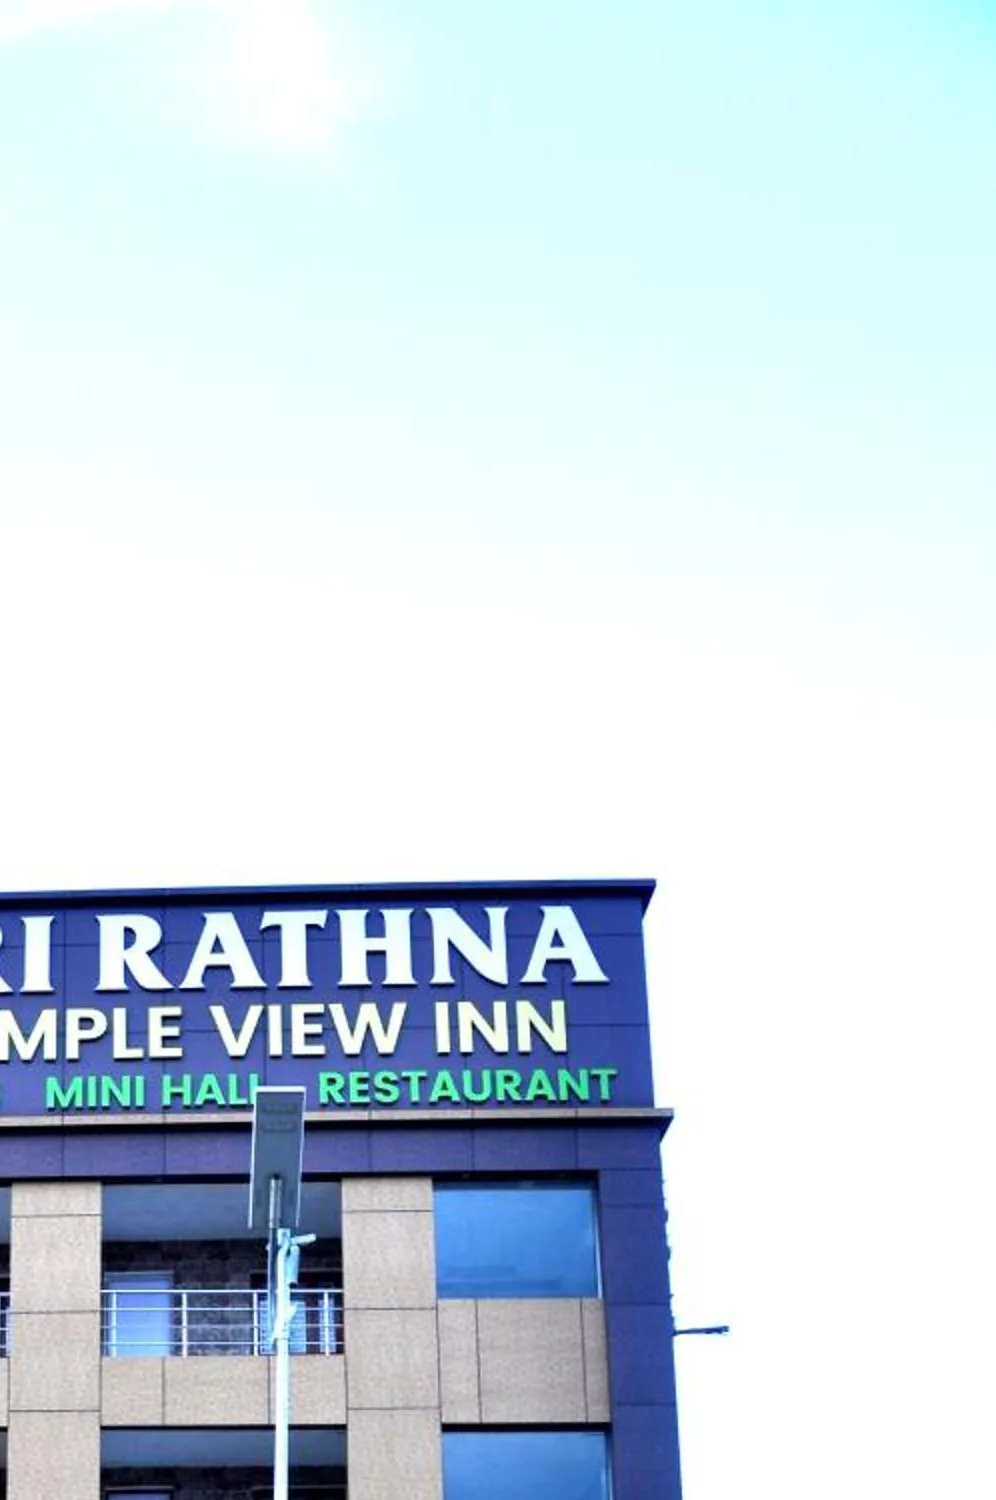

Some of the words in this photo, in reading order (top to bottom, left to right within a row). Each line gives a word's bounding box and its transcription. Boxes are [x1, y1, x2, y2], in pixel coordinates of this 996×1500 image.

[94, 905, 610, 990] RATHNA
[208, 1001, 408, 1060] VIEW
[434, 999, 569, 1055] INN
[44, 1074, 146, 1109] MINI
[318, 1066, 619, 1106] RESTAURANT
